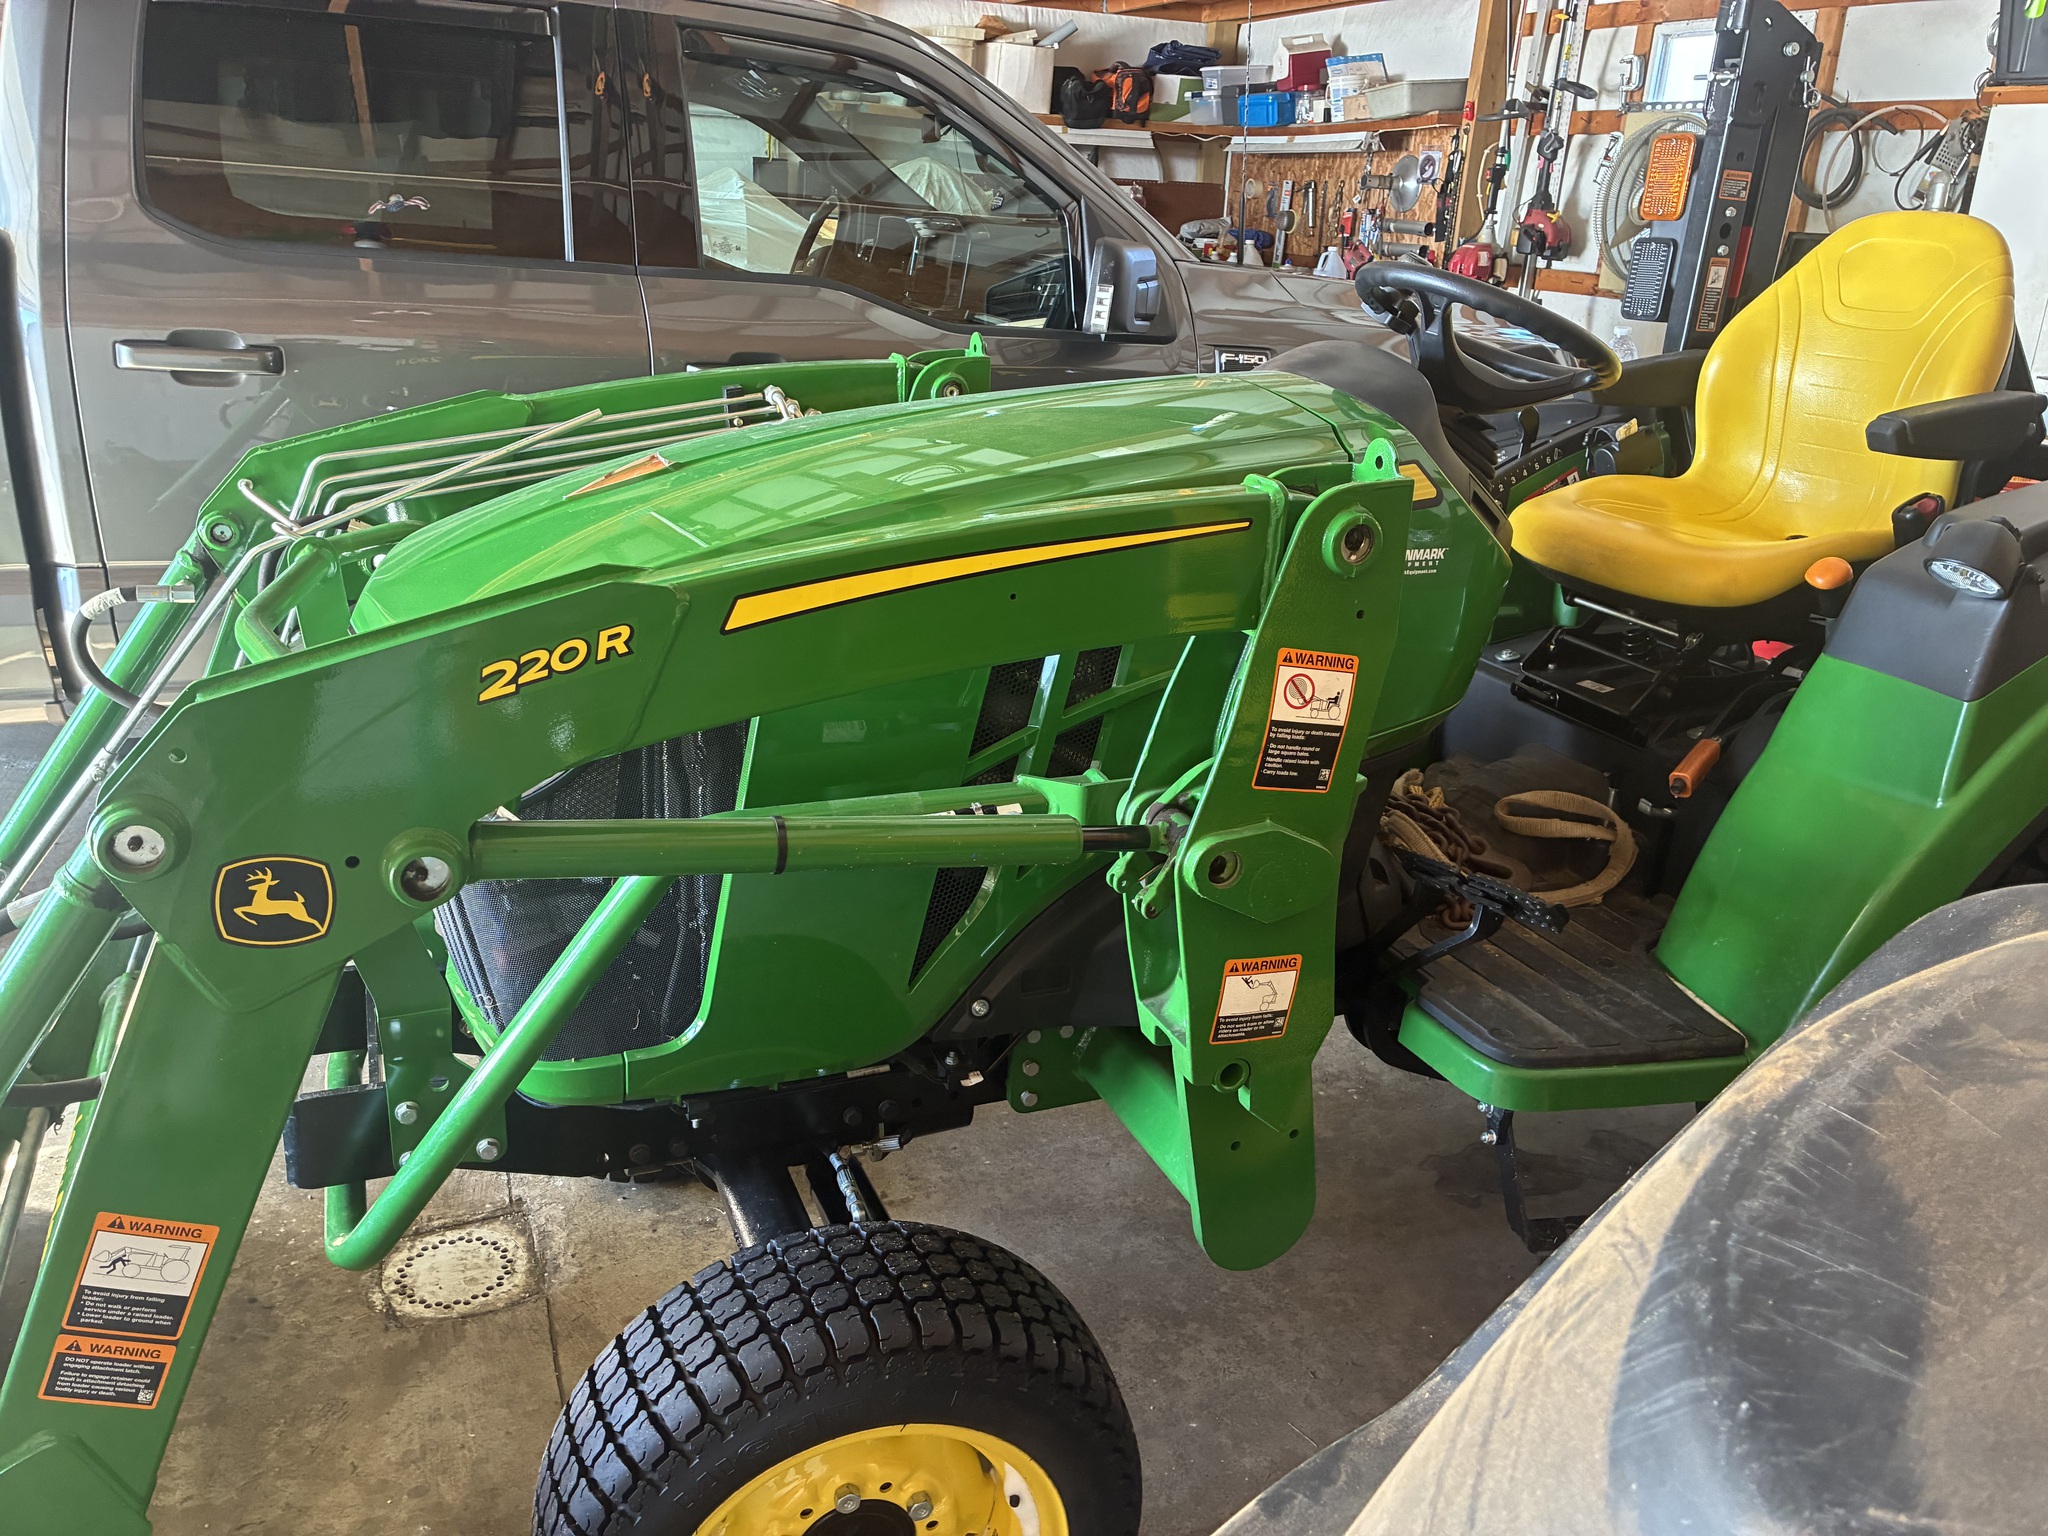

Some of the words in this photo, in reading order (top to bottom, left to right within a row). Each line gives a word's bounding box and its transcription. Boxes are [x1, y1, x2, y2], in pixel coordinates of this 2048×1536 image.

[1221, 353, 1268, 364] F-150
[1498, 484, 1504, 492] 2
[1510, 476, 1516, 484] 3
[1534, 462, 1540, 470] 5
[1546, 456, 1551, 464] 6
[1405, 548, 1446, 561] NMARK
[1295, 652, 1354, 669] WARNING
[1242, 958, 1297, 972] WARNING
[129, 1220, 202, 1238] WARNING
[111, 1292, 129, 1300] injury
[90, 1343, 161, 1359] WARNING
